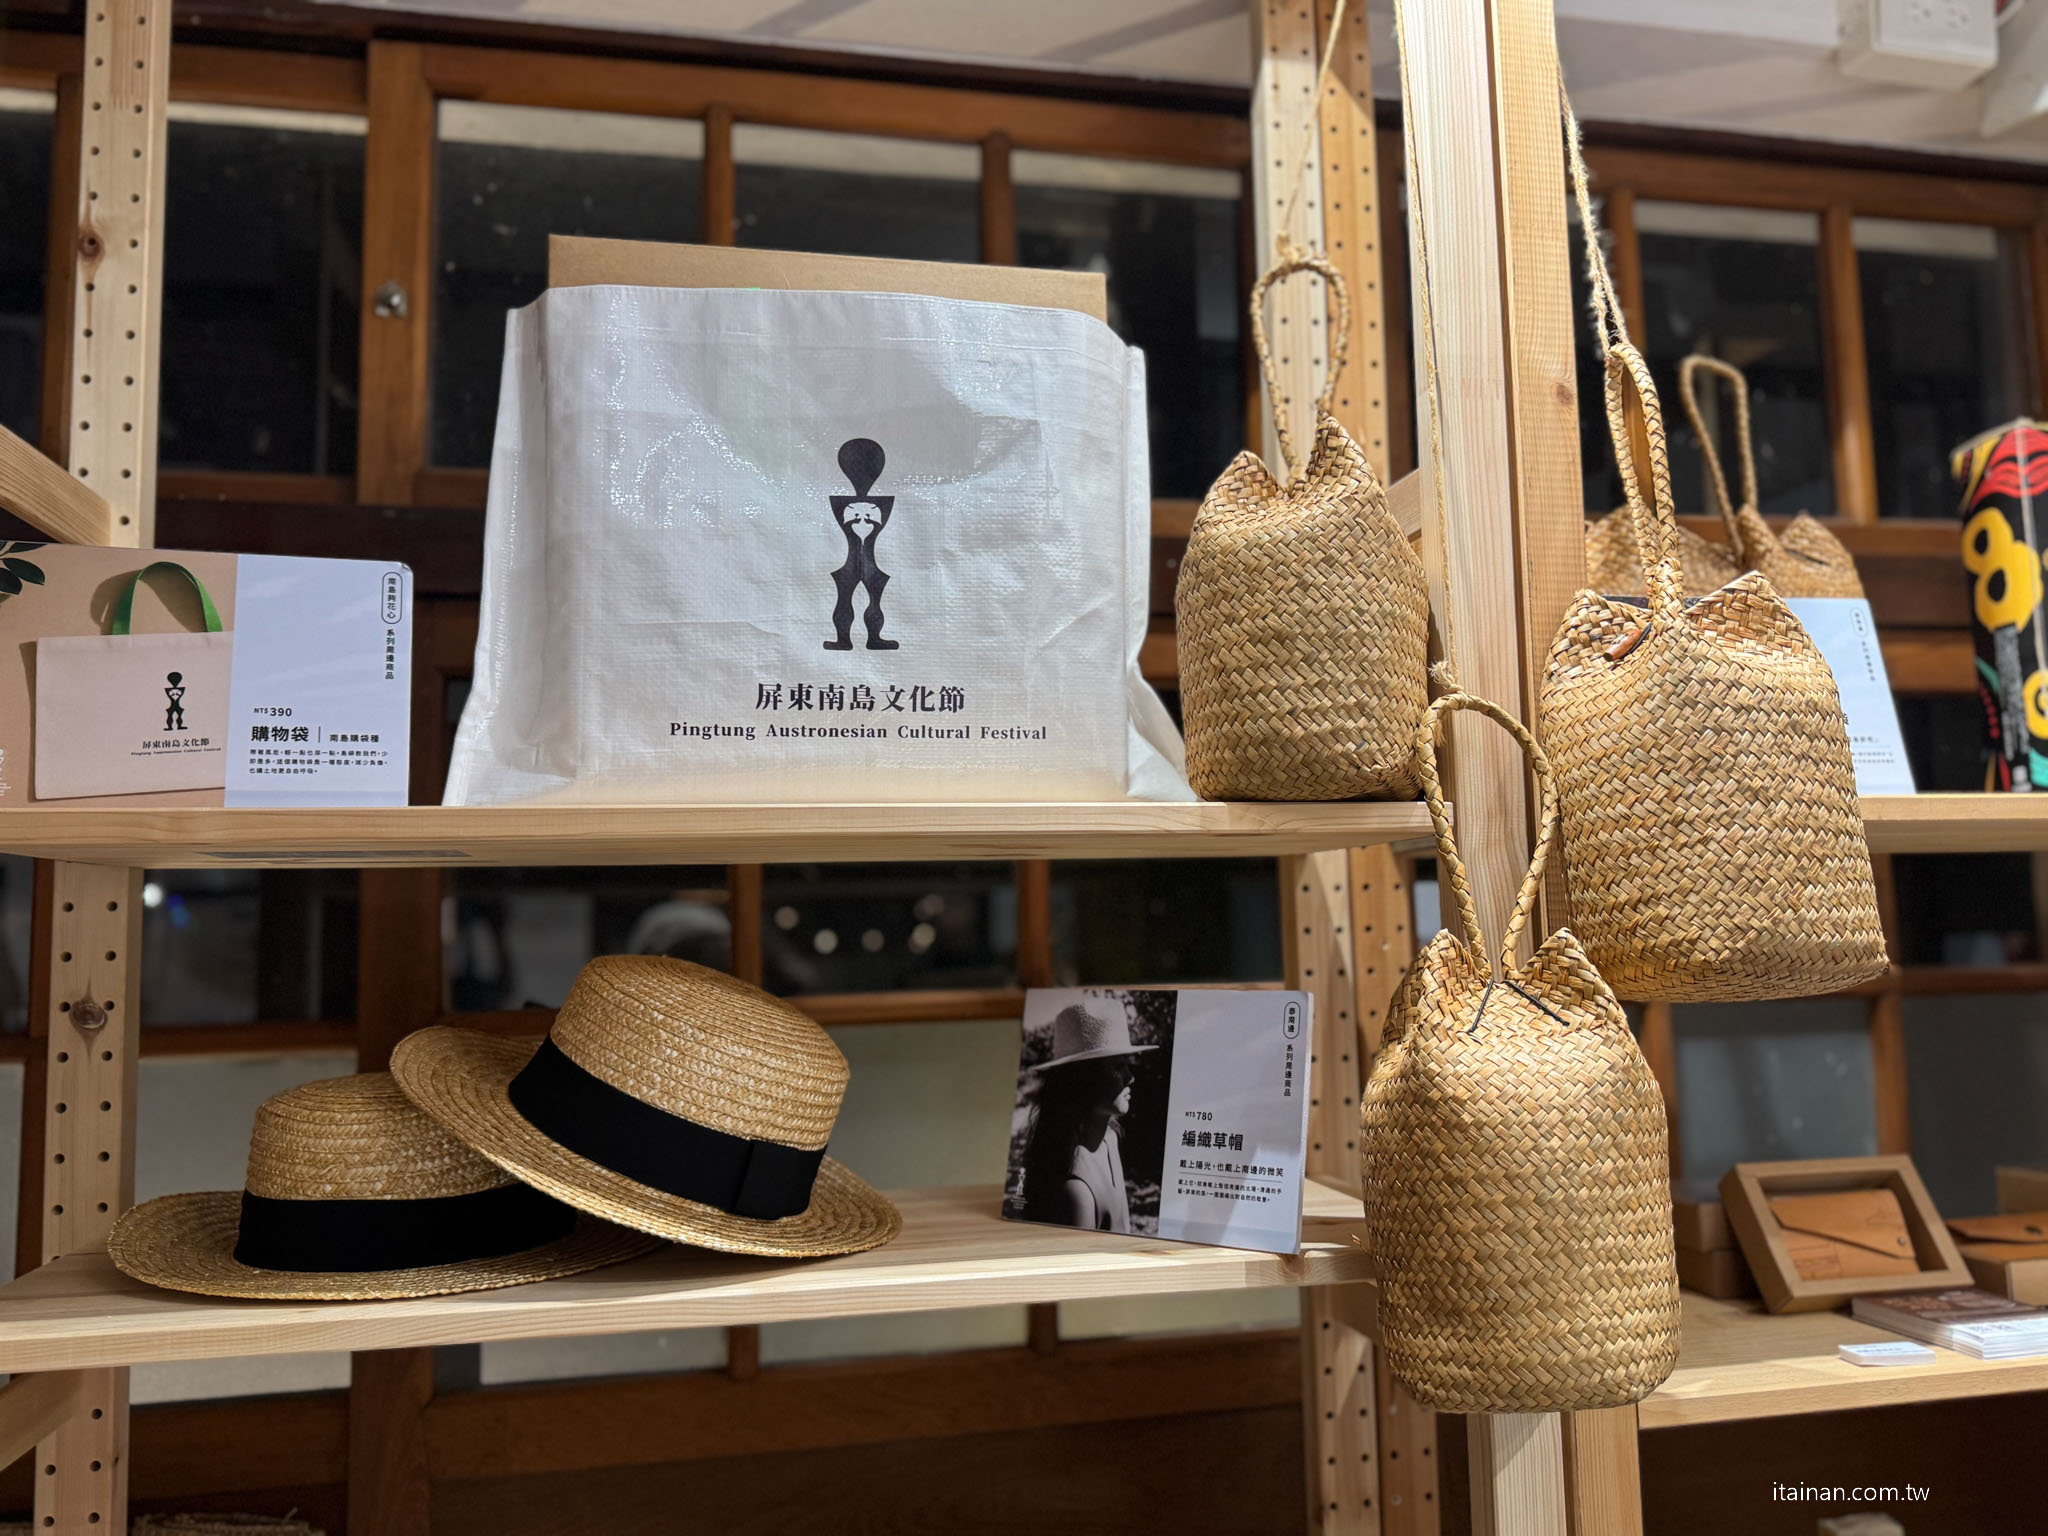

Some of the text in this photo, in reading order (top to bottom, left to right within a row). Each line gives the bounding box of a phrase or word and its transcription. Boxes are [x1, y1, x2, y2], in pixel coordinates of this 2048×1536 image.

[385, 628, 395, 680] 系列周邊商品
[755, 682, 966, 714] 屏東南島文化節
[251, 725, 309, 742] 購物袋
[669, 721, 1047, 741] Pingtung Austronesian Cultural Festival
[1284, 1044, 1294, 1097] 系列周邊商品
[1181, 1130, 1244, 1151] 編織草帽
